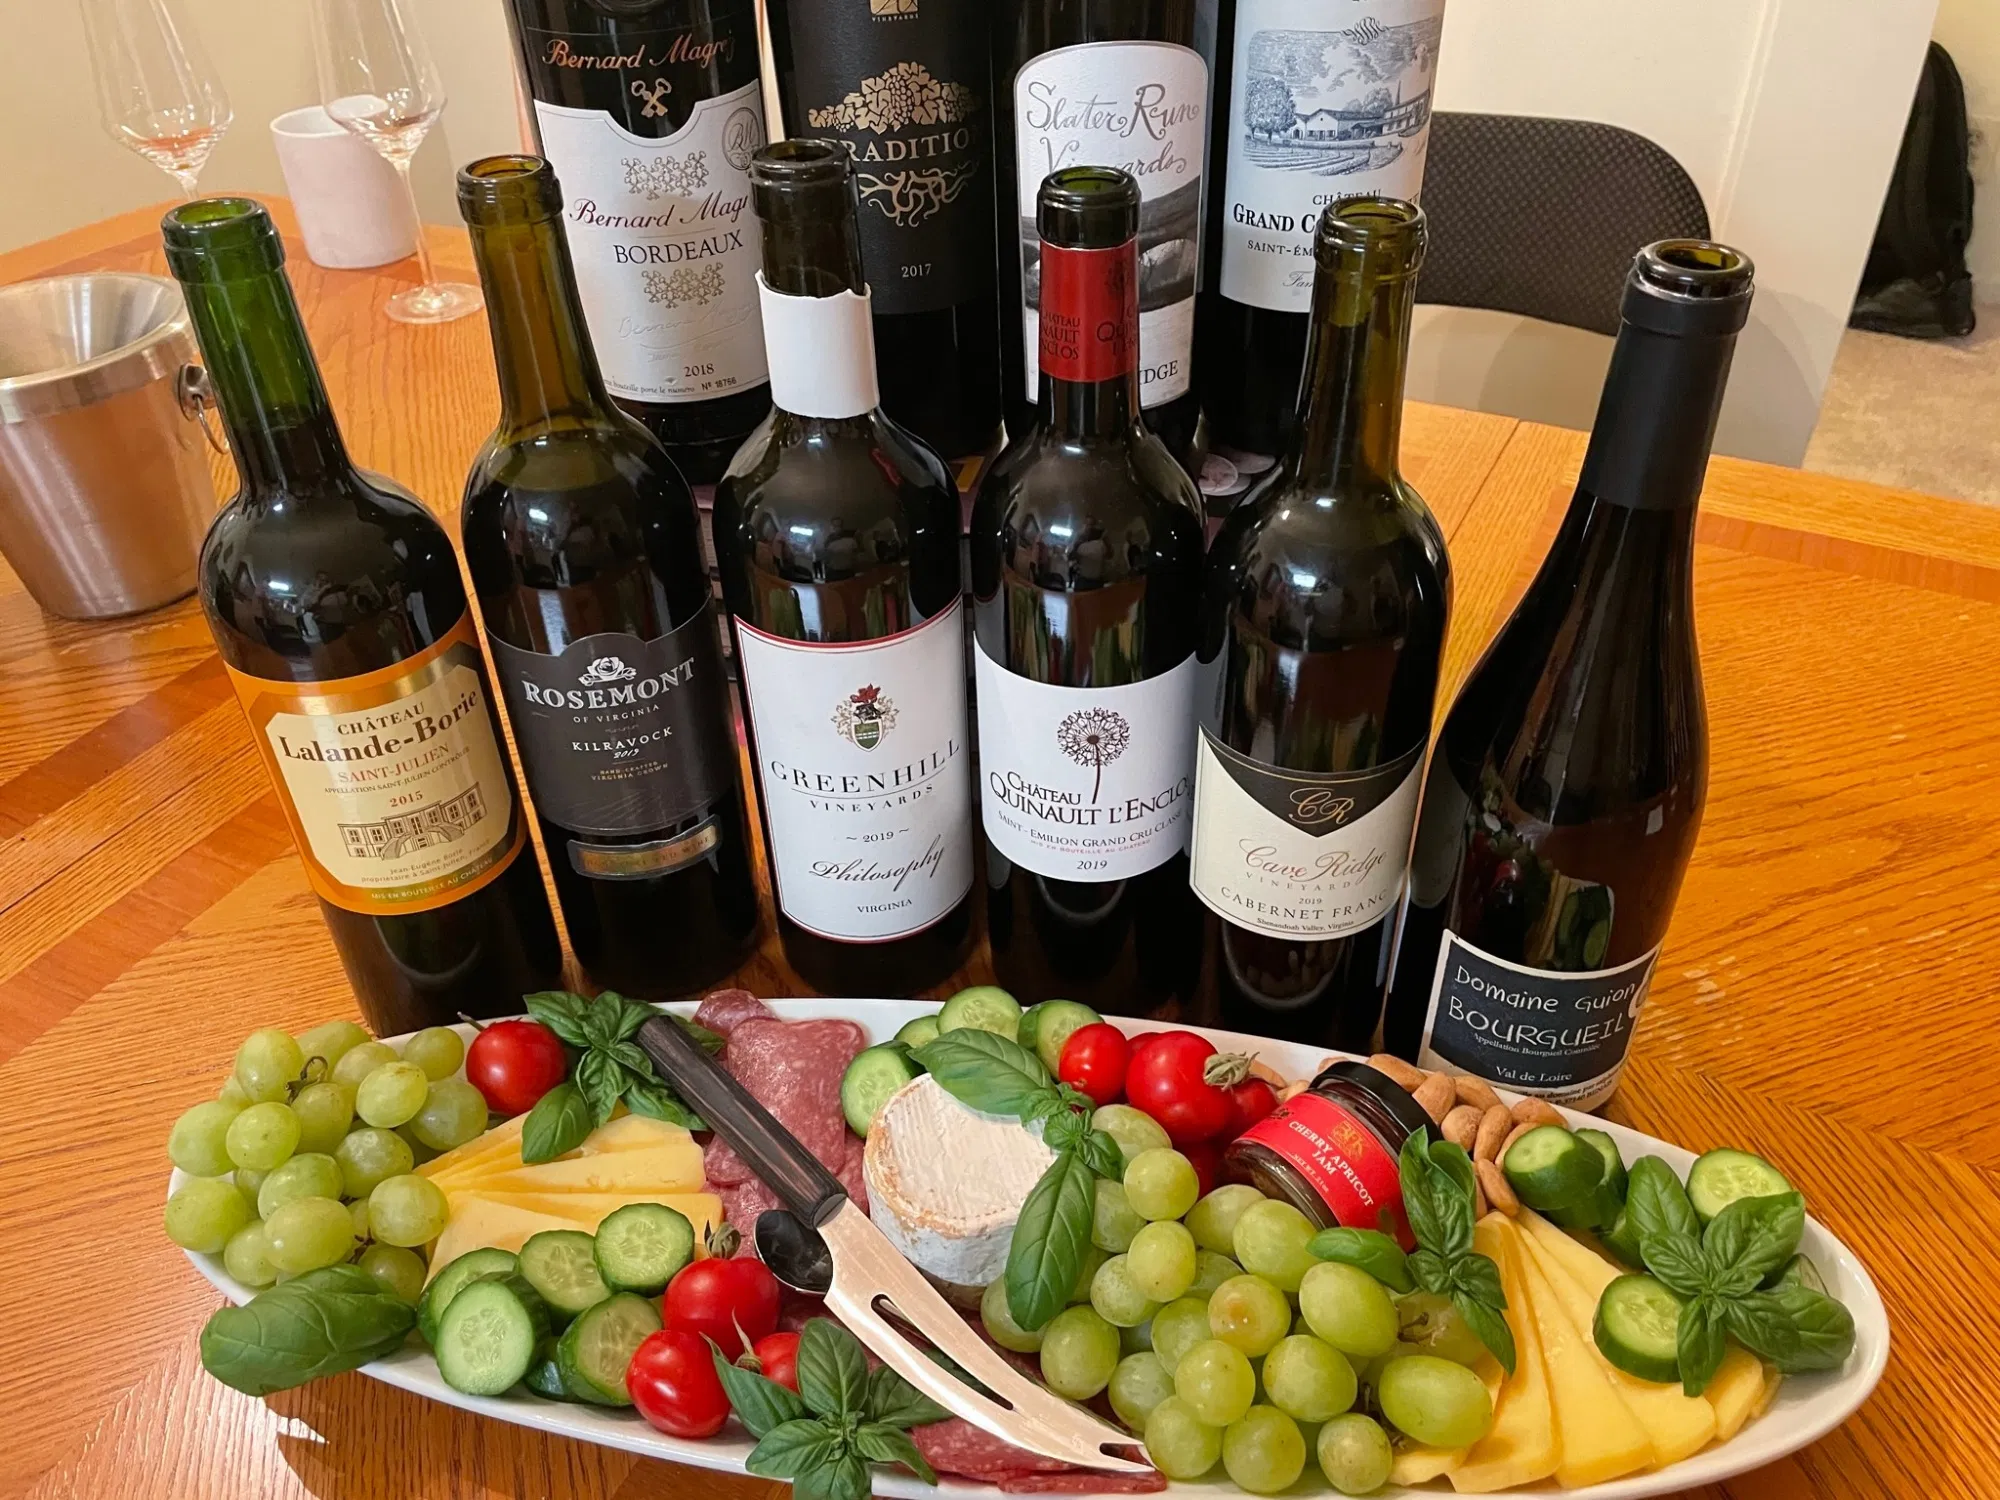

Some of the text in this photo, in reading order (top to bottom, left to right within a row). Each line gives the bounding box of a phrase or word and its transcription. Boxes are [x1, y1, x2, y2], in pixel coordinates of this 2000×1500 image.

[542, 39, 646, 69] Bernard
[1027, 81, 1200, 141] Slater Run
[838, 127, 970, 163] RADITIO
[569, 197, 675, 230] Bernard
[1233, 203, 1295, 232] GRAND
[613, 229, 744, 264] BORDEAUX
[1247, 239, 1314, 257] SAINT-ÉM
[901, 263, 932, 278] 2017
[683, 363, 715, 377] 2018
[1139, 360, 1179, 385] DGE
[521, 656, 696, 710] ROSEMONT
[278, 689, 479, 763] Lalande-Borie
[337, 702, 426, 736] CHÂTEAU
[573, 703, 660, 724] OF VIRGINIA
[571, 726, 673, 752] KILRAVOCK
[613, 748, 640, 759] 2019
[338, 743, 450, 784] SAINT-JULIEN
[770, 738, 960, 794] GREENHILL
[324, 785, 376, 794] APPELLATION
[377, 771, 431, 791] SAINT-JULIEN
[1007, 771, 1082, 806] CHÂTEAU
[389, 790, 424, 808] 2015
[810, 783, 934, 812] VINEYARDS
[989, 771, 1189, 826] QUINAULT L'ENCLO
[862, 830, 895, 843] 2019
[1082, 836, 1127, 848] GRAND
[1129, 828, 1152, 842] CRU
[808, 834, 945, 892] Philosophy
[1076, 860, 1108, 870] 2019
[1238, 838, 1387, 886] Cave Ridge
[371, 892, 387, 900] MIS
[447, 877, 459, 886] AU
[1220, 886, 1388, 920] CABERNET FRANC
[1298, 897, 1323, 905] 2019
[857, 898, 913, 914] VIRGINIA
[1256, 917, 1300, 931] Shenandoah
[1327, 920, 1355, 931] Virginia
[1454, 964, 1636, 1014] Domaine Guion
[1448, 995, 1625, 1050] BOURGUEIL
[1472, 1032, 1520, 1053] Appellation
[1495, 1066, 1573, 1082] Val de Loire
[1288, 1120, 1375, 1207] CHERRY APRICOT
[1311, 1150, 1338, 1176] JAM
